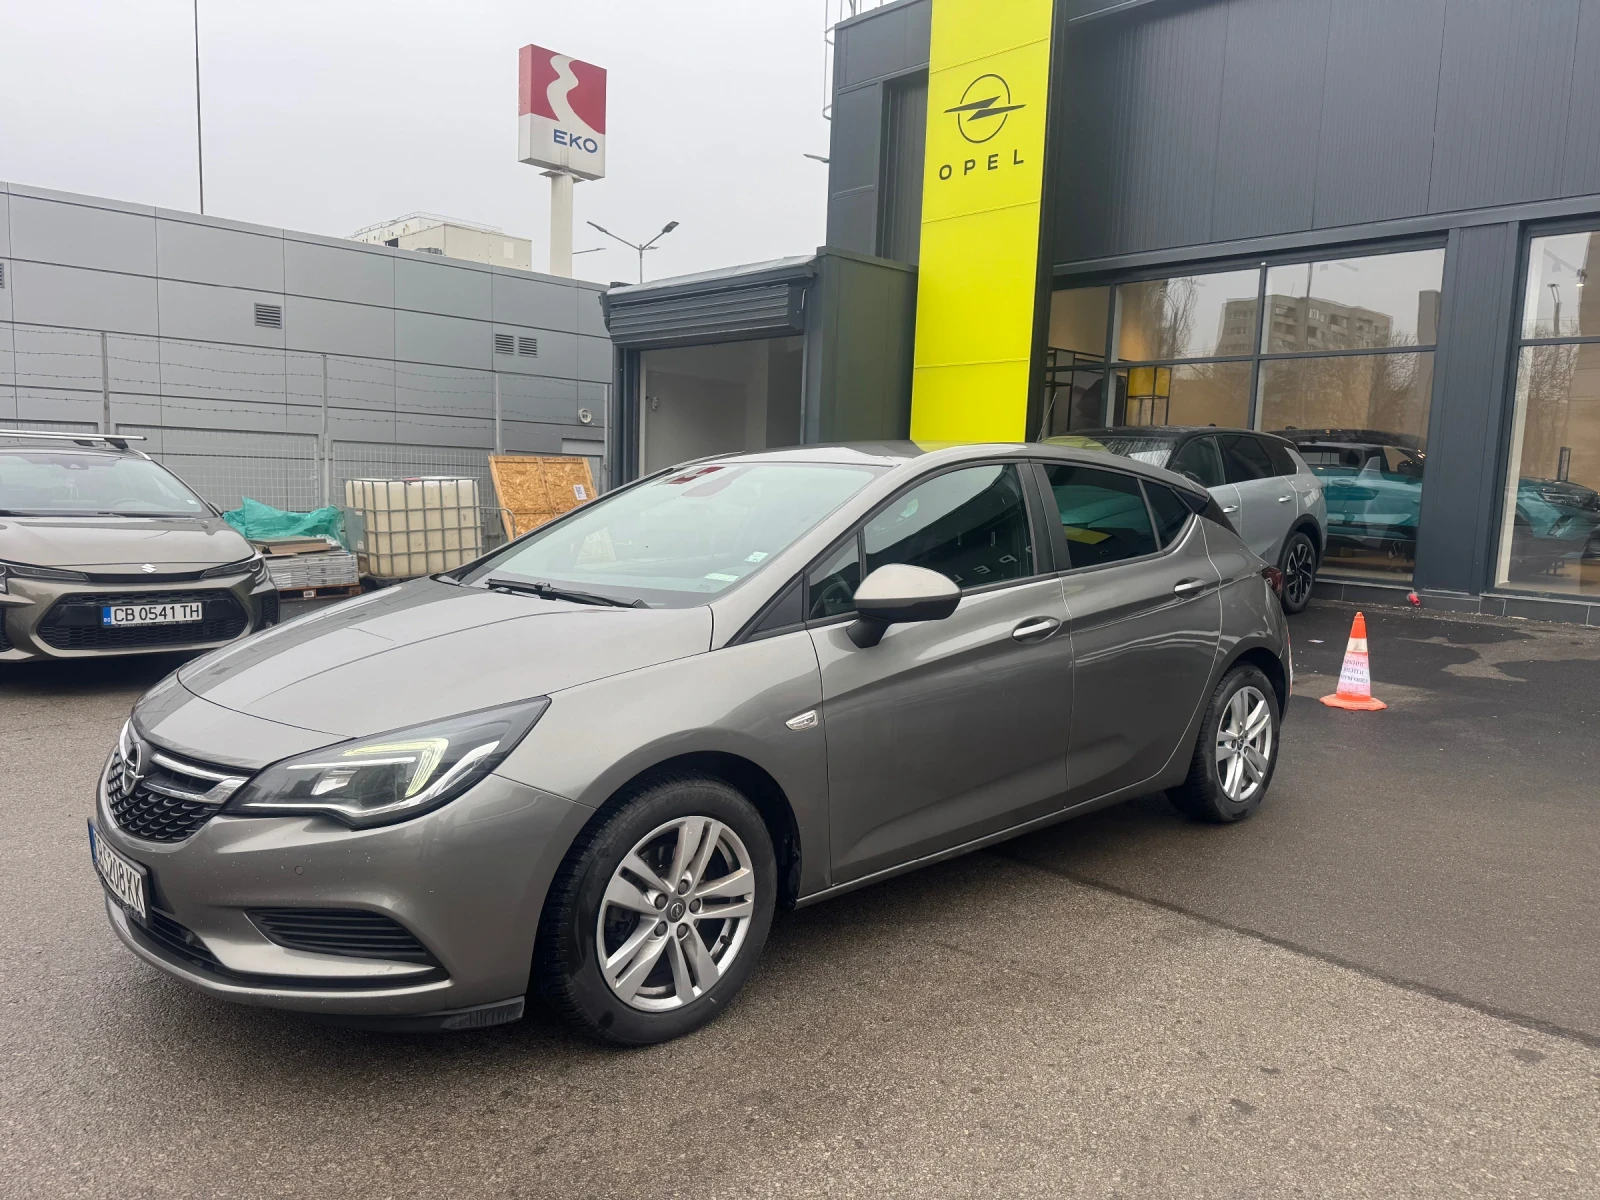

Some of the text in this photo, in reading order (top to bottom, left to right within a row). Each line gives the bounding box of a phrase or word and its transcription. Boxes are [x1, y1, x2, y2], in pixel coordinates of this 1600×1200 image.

[553, 128, 598, 154] EKO
[938, 149, 1024, 180] OPEL
[114, 604, 200, 622] CB 0541 TH
